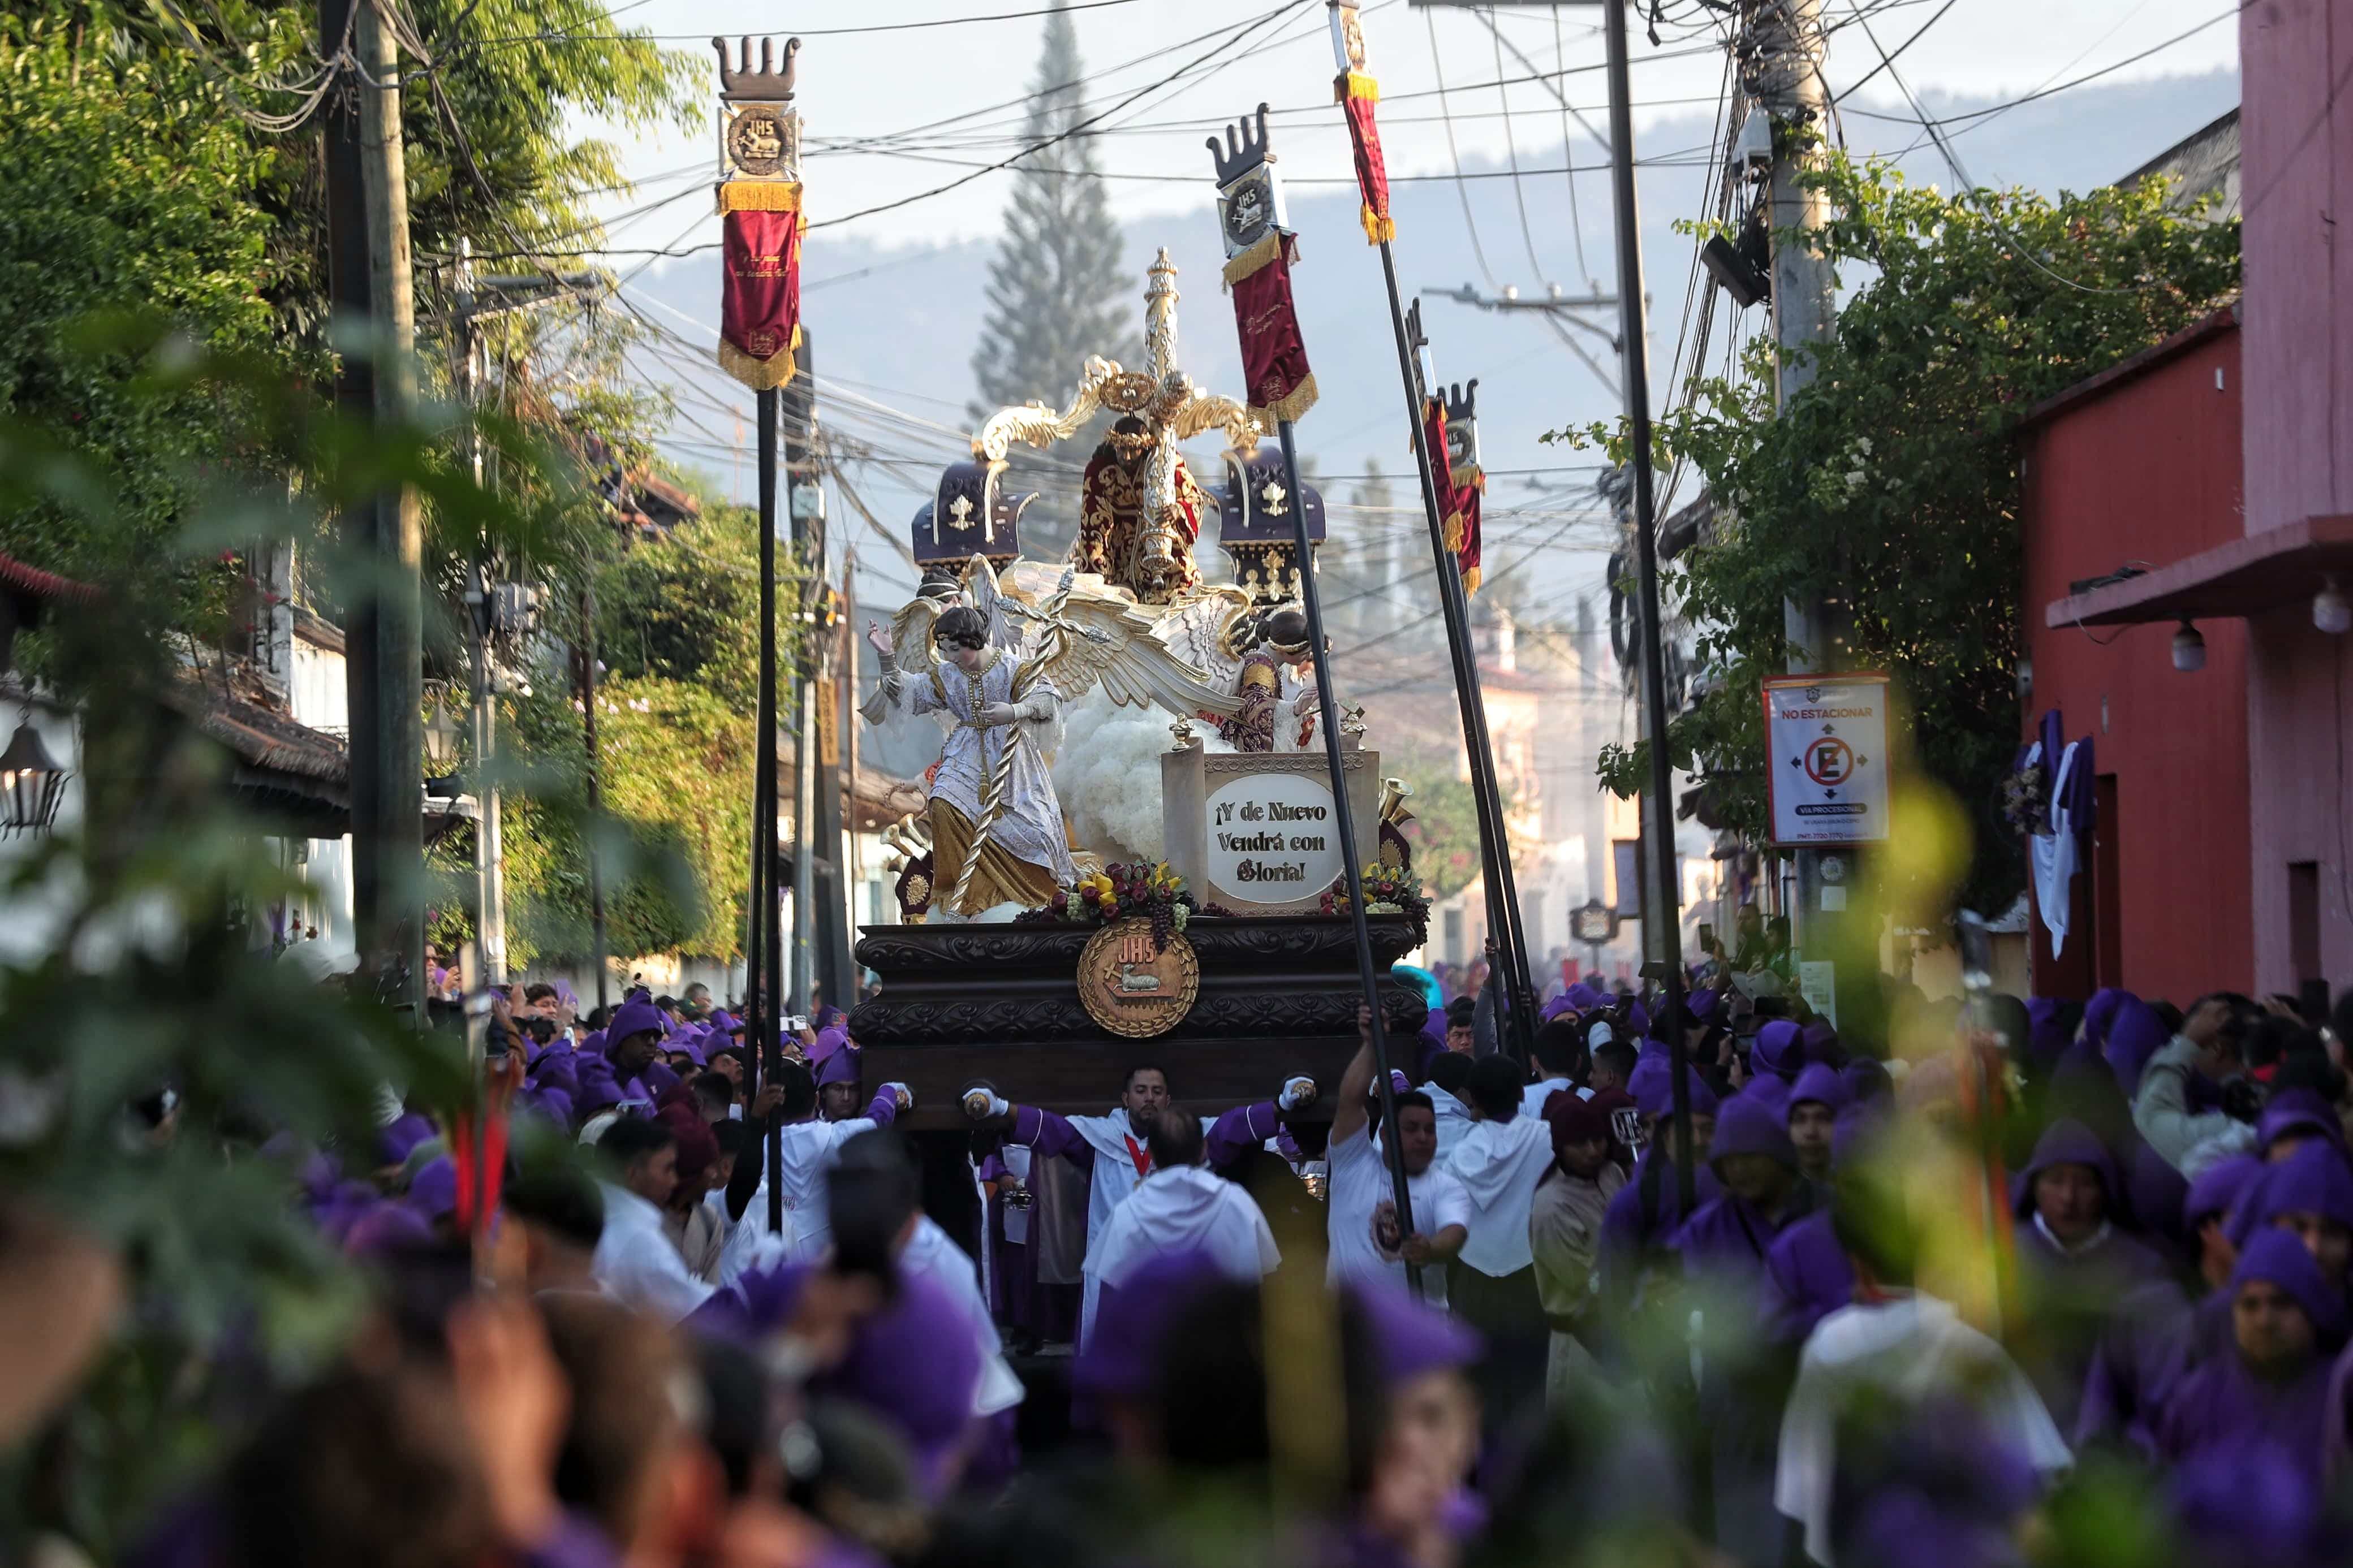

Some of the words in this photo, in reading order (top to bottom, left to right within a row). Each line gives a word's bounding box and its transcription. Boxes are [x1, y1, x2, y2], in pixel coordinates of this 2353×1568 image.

[1782, 710, 1799, 720] NO
[1801, 707, 1873, 719] ESTACIONAR
[1216, 801, 1236, 826] ¡Y
[1240, 800, 1265, 822] de
[1268, 801, 1327, 822] Nuevo
[1217, 831, 1285, 852] Vendrá
[1290, 836, 1326, 852] con
[1237, 858, 1306, 882] Gloria!
[1118, 936, 1156, 964] JHS
